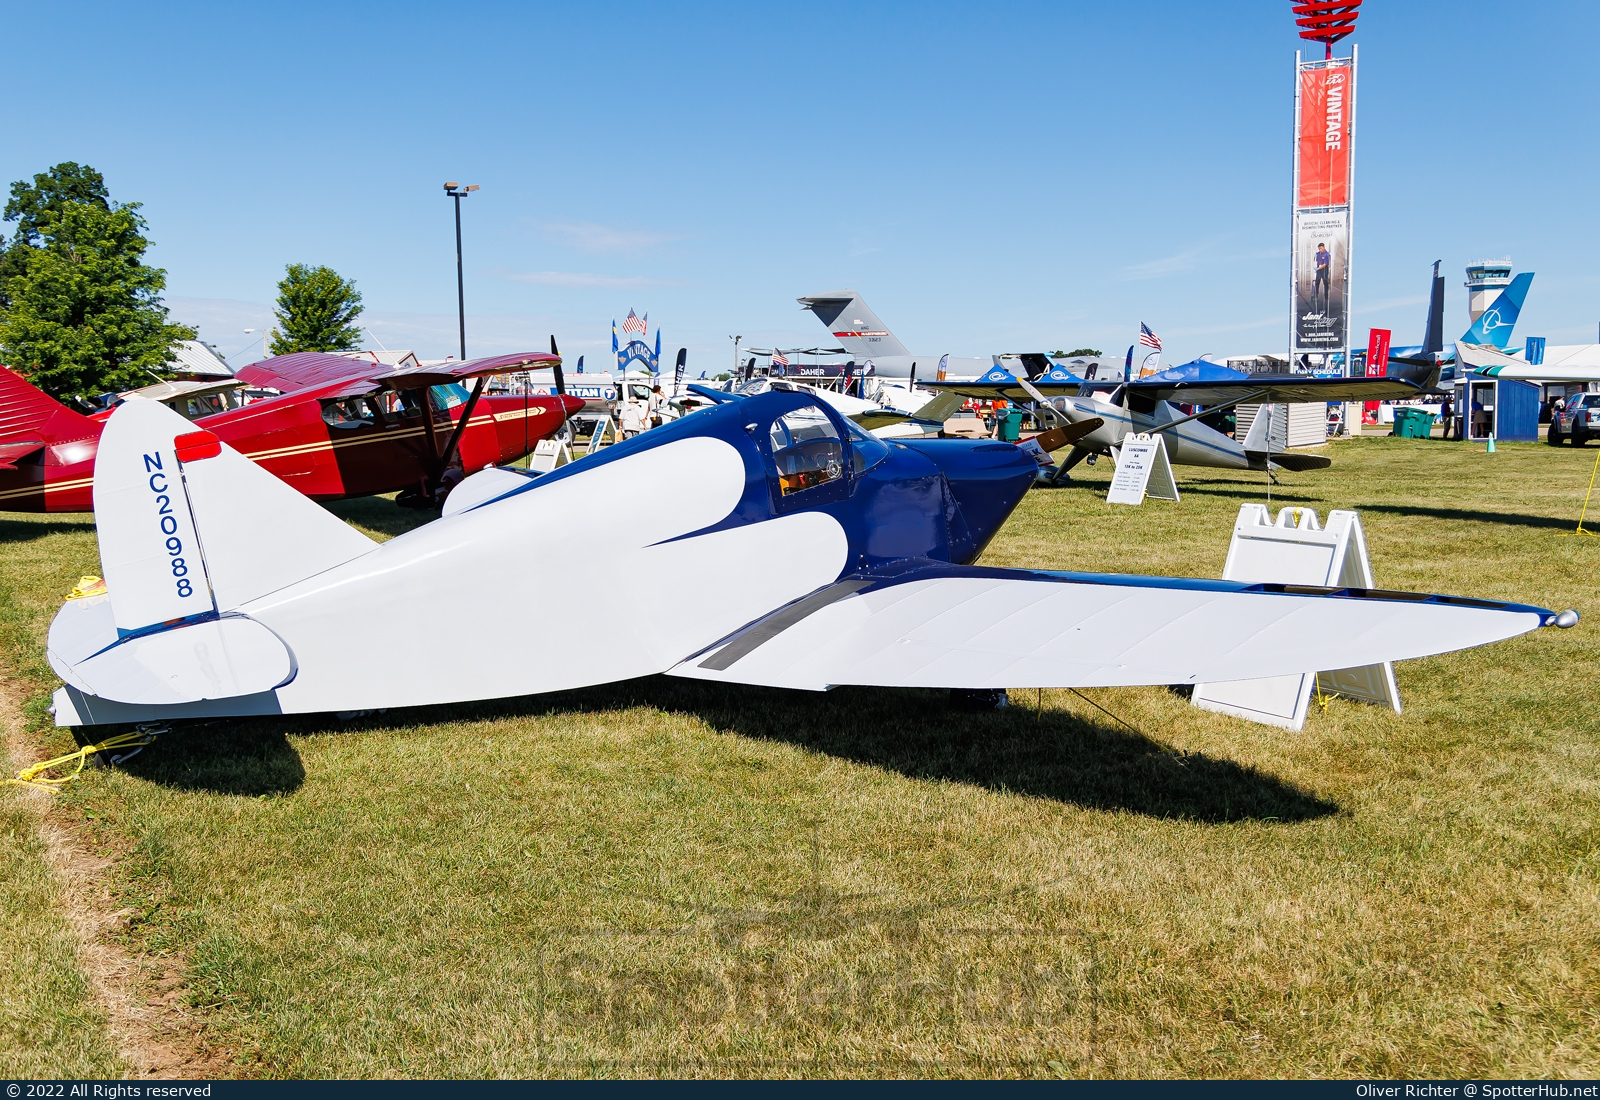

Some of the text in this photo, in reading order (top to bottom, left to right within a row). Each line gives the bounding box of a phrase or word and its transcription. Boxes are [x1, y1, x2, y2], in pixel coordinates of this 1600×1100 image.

[1325, 86, 1343, 151] VINTAGE
[627, 343, 651, 362] VINTAGE
[800, 368, 825, 376] DAHER
[565, 388, 599, 397] TITAN
[143, 451, 193, 598] NC20988
